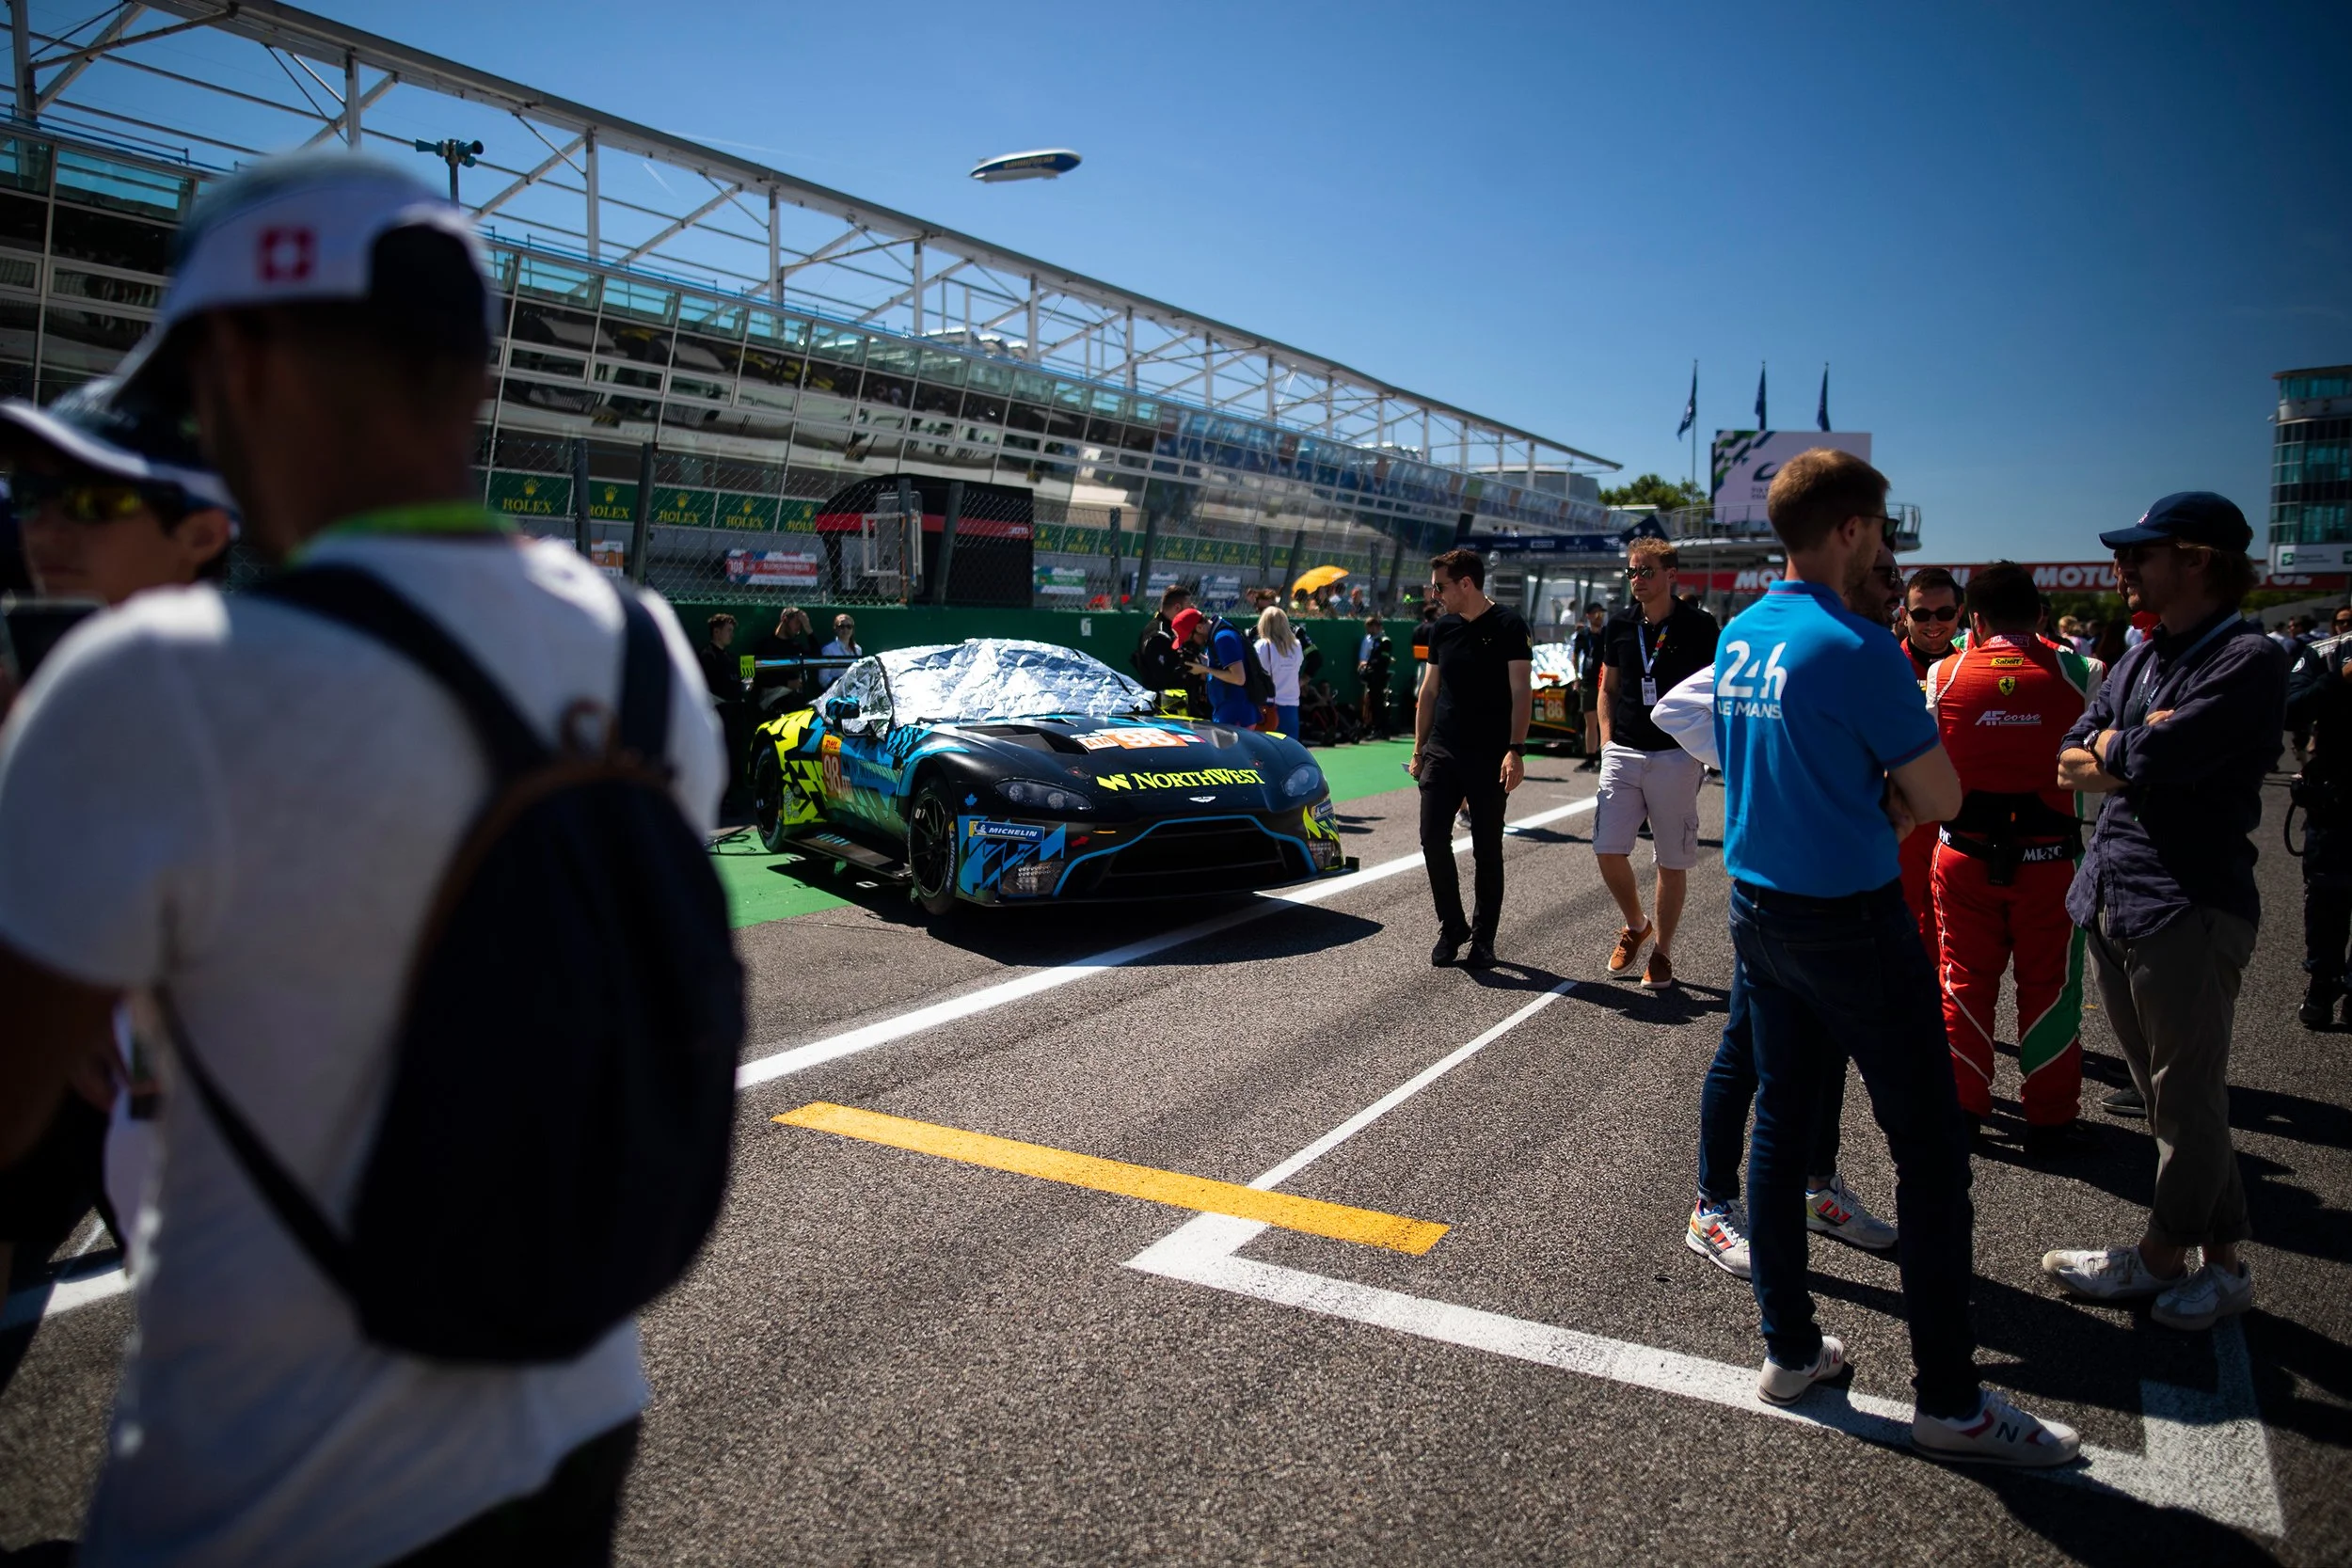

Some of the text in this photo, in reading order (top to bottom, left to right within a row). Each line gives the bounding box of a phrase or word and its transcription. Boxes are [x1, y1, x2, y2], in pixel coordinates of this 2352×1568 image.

[502, 498, 552, 515] ROLEX
[659, 511, 699, 524] ROLEX
[726, 515, 764, 529] ROLEX
[1547, 700, 1563, 719] 86
[1717, 701, 1782, 719] LE MANS
[825, 739, 838, 750] DHL
[1086, 731, 1179, 748] AM 98
[823, 755, 841, 793] 98
[988, 827, 1038, 838] MICHELIN
